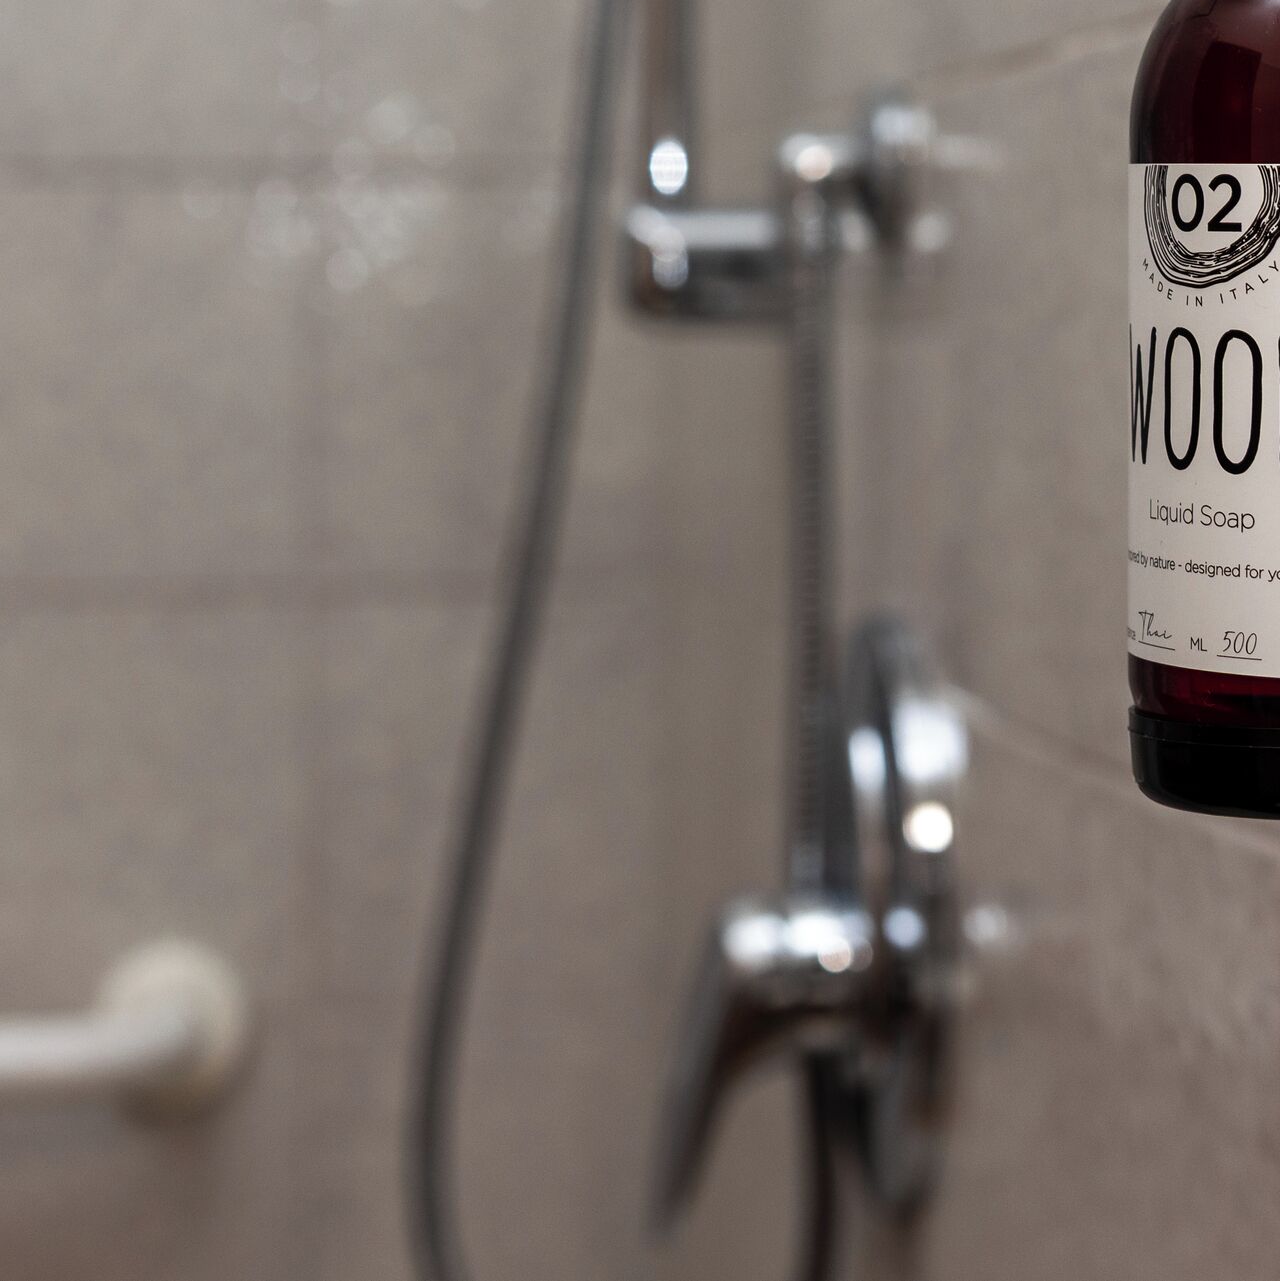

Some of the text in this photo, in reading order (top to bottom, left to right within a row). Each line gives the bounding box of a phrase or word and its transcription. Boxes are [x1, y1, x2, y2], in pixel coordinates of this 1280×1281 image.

[1171, 173, 1243, 232] 02
[1142, 258, 1280, 307] MADE IN ITALY
[1149, 498, 1256, 533] Liquid Soap
[1141, 552, 1148, 568] by
[1149, 556, 1176, 571] nature
[1184, 559, 1241, 578] designed
[1245, 564, 1264, 579] for
[1138, 610, 1172, 641] Thai
[1190, 636, 1208, 652] ML
[1222, 630, 1258, 655] 500
